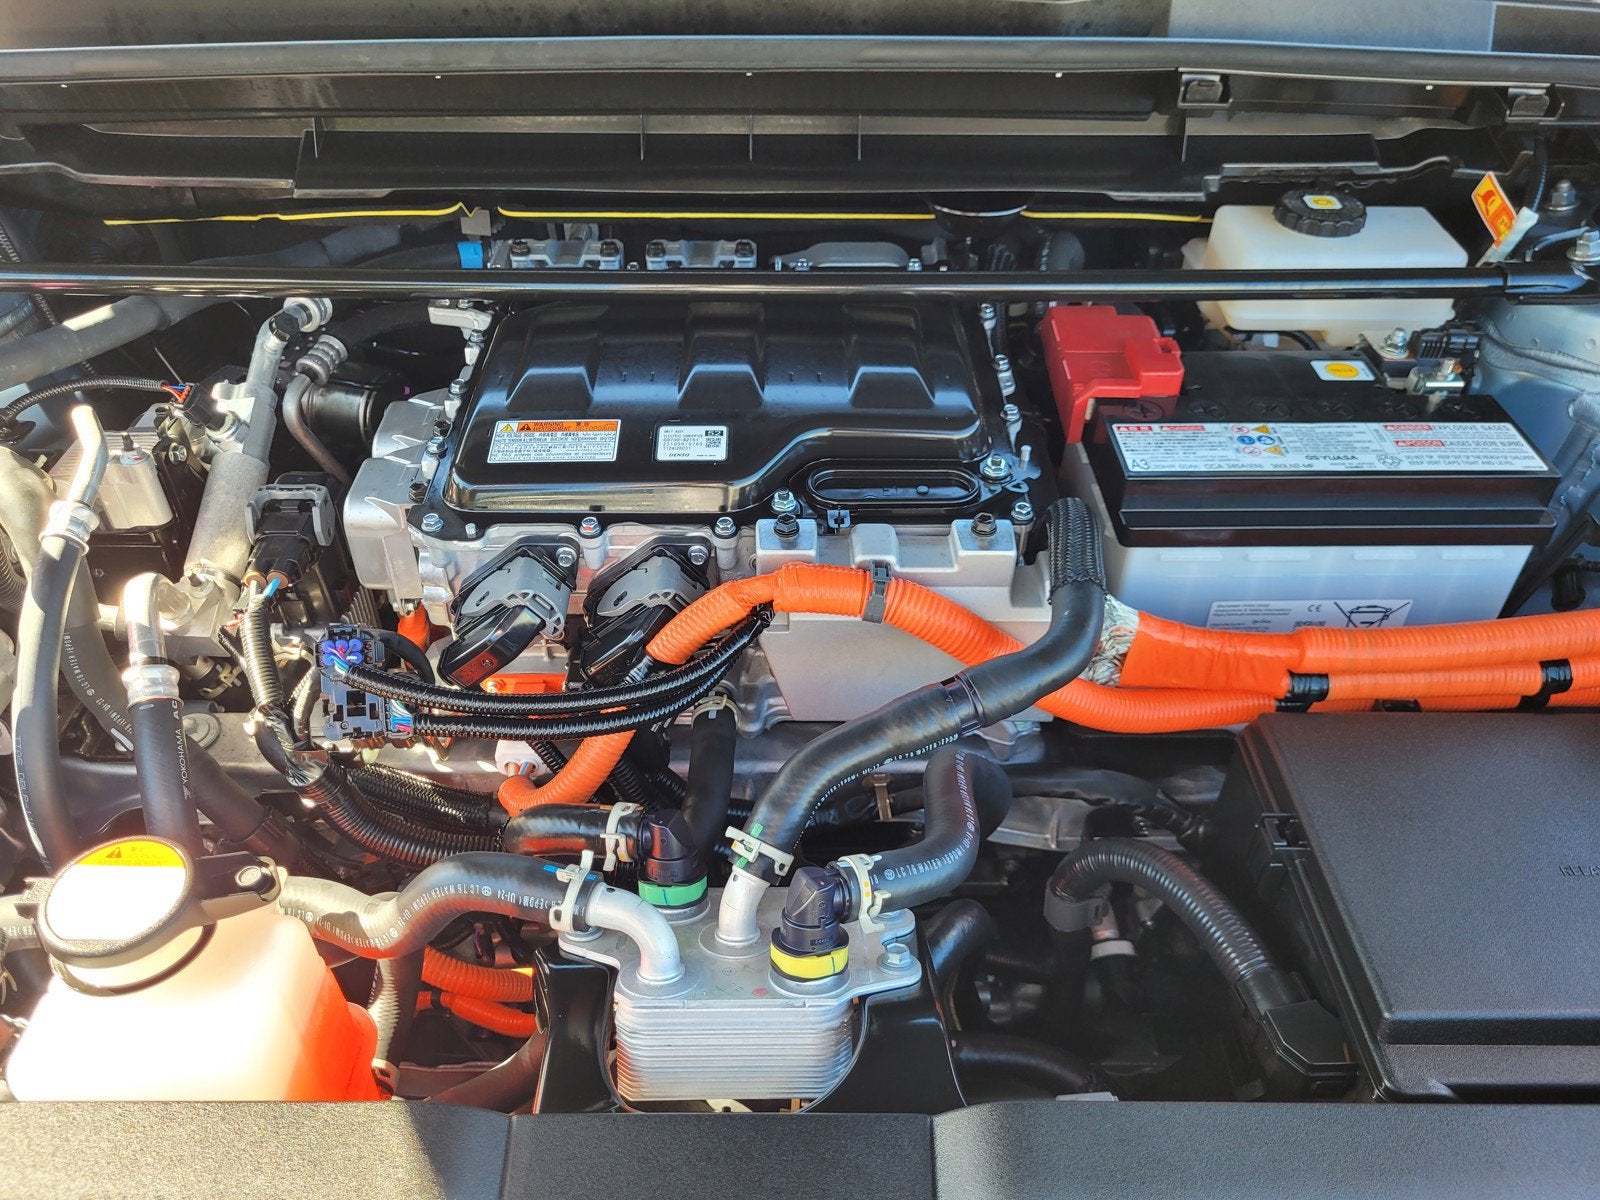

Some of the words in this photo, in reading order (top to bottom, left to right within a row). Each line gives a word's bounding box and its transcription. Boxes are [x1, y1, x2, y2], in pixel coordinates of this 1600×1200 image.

[1131, 459, 1150, 470] A3
[175, 728, 188, 784] YOKOHAMA
[915, 742, 938, 756] WATER
[917, 858, 943, 873] WATER
[432, 884, 455, 903] WATER
